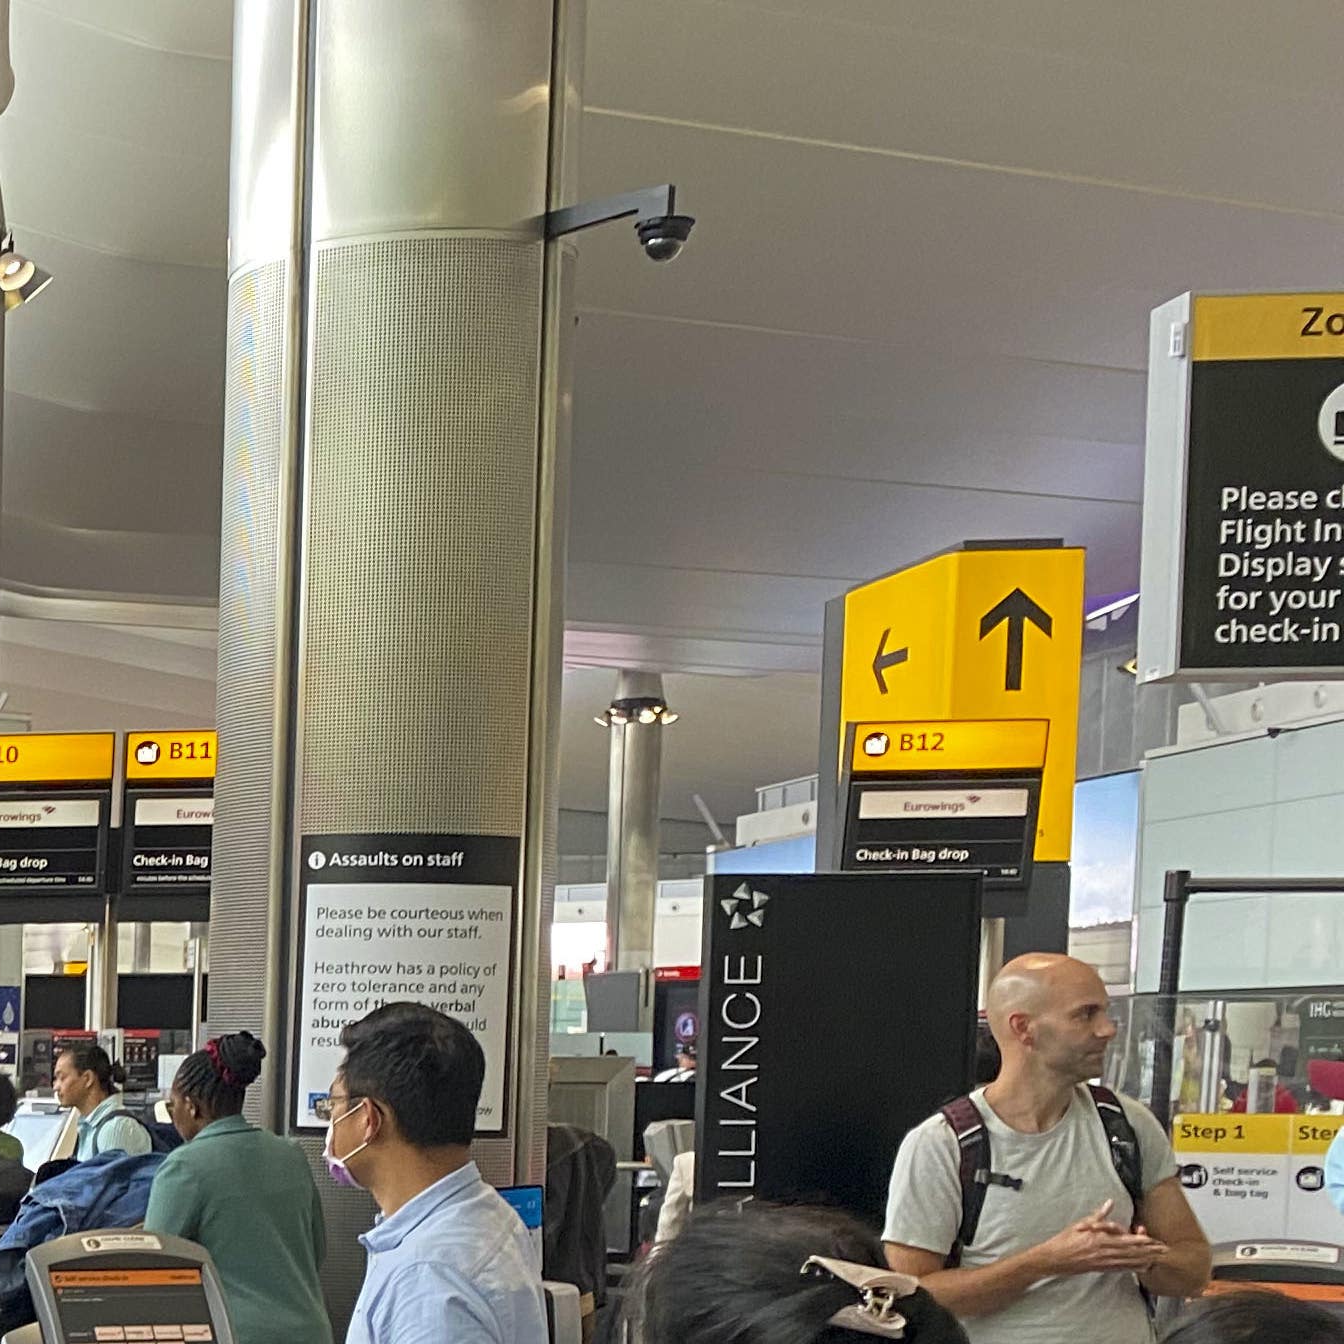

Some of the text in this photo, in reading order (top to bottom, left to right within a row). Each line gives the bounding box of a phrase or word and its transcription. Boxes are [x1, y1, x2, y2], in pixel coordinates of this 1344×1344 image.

[1221, 485, 1319, 511] Please
[1219, 518, 1344, 549] Flight In
[1218, 551, 1333, 582] Display
[1216, 585, 1342, 616] for your
[1214, 617, 1340, 644] check-in
[169, 741, 213, 760] B11
[899, 732, 945, 752] B12
[903, 801, 966, 814] Eurowings
[19, 856, 49, 871] drop
[132, 853, 209, 870] Check-in Bag
[328, 850, 464, 868] Assaults on staff
[855, 848, 970, 863] Check-in Bag drop
[316, 906, 504, 921] Please be courteous when
[315, 924, 482, 941] dealing with our staff.
[313, 961, 498, 979] Heathrow has a policy of
[312, 980, 485, 998] zero tolerance and any
[312, 998, 349, 1011] form
[353, 998, 369, 1011] of
[311, 1036, 342, 1047] resu
[717, 954, 763, 1208] LLIANCE
[1180, 1123, 1245, 1142] Step 1
[1213, 1166, 1278, 1176] Self service
[1212, 1177, 1260, 1187] check-in
[1212, 1188, 1269, 1199] & bag tag
